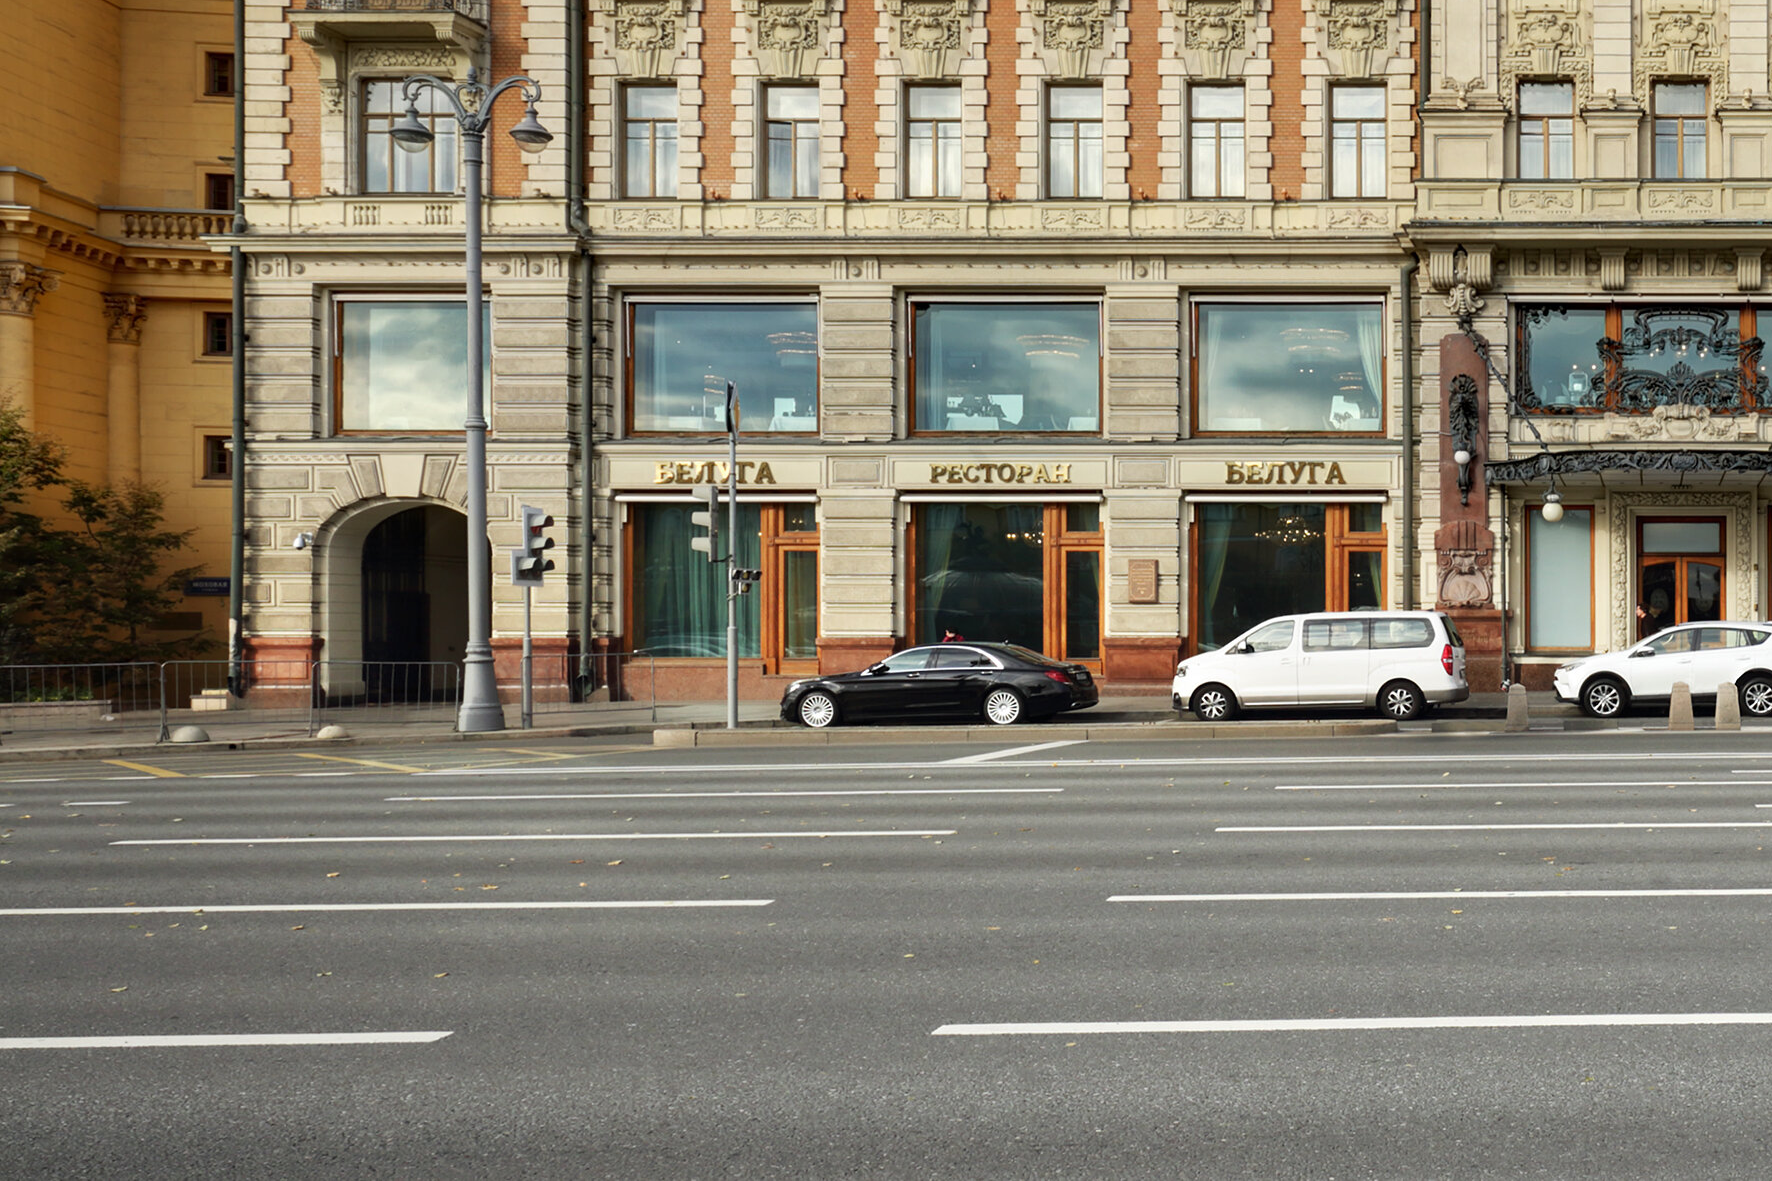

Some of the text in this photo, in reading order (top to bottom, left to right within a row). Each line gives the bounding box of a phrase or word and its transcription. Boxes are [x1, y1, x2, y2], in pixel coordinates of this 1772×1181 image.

[653, 460, 777, 485] БЕЛУГА
[929, 463, 1072, 484] РЕСТОРАН
[1225, 461, 1347, 485] БЕЛУГА
